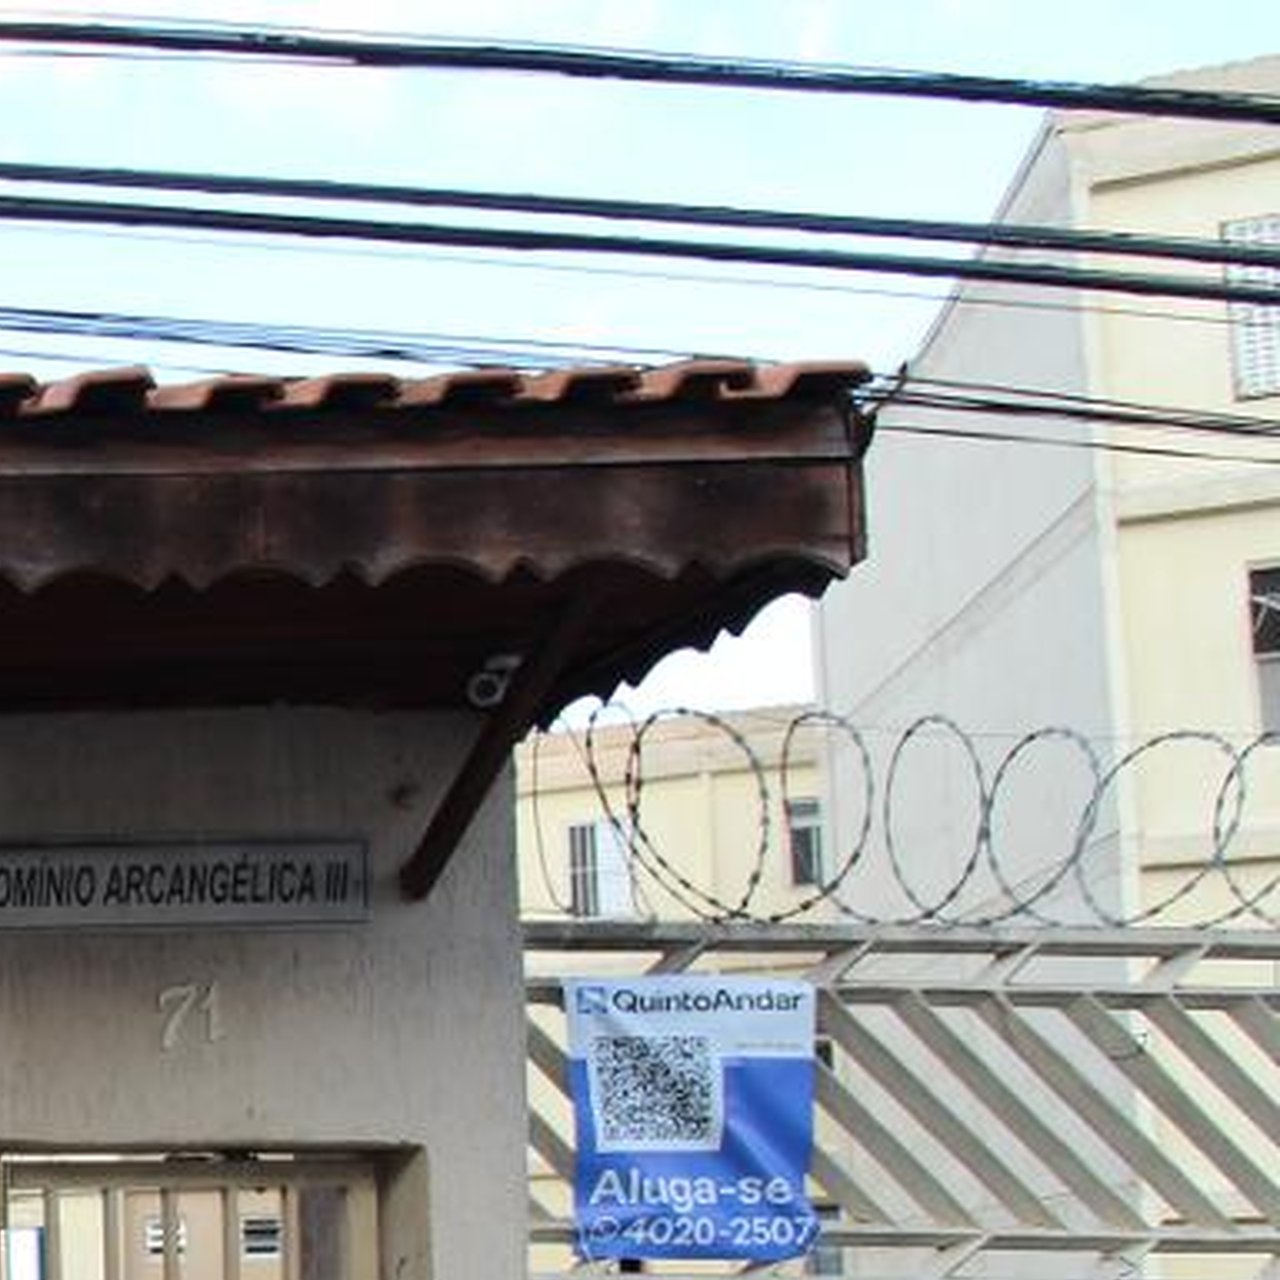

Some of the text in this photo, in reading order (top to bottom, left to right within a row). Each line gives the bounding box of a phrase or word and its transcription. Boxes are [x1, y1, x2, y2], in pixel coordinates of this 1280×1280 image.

[103, 856, 316, 905] ARCANGÉLICA
[325, 861, 349, 900] III
[157, 980, 225, 1052] 71
[612, 988, 802, 1014] QuintoAndar
[589, 1168, 793, 1213] Aluga-se
[624, 1217, 816, 1246] 4020-2507
